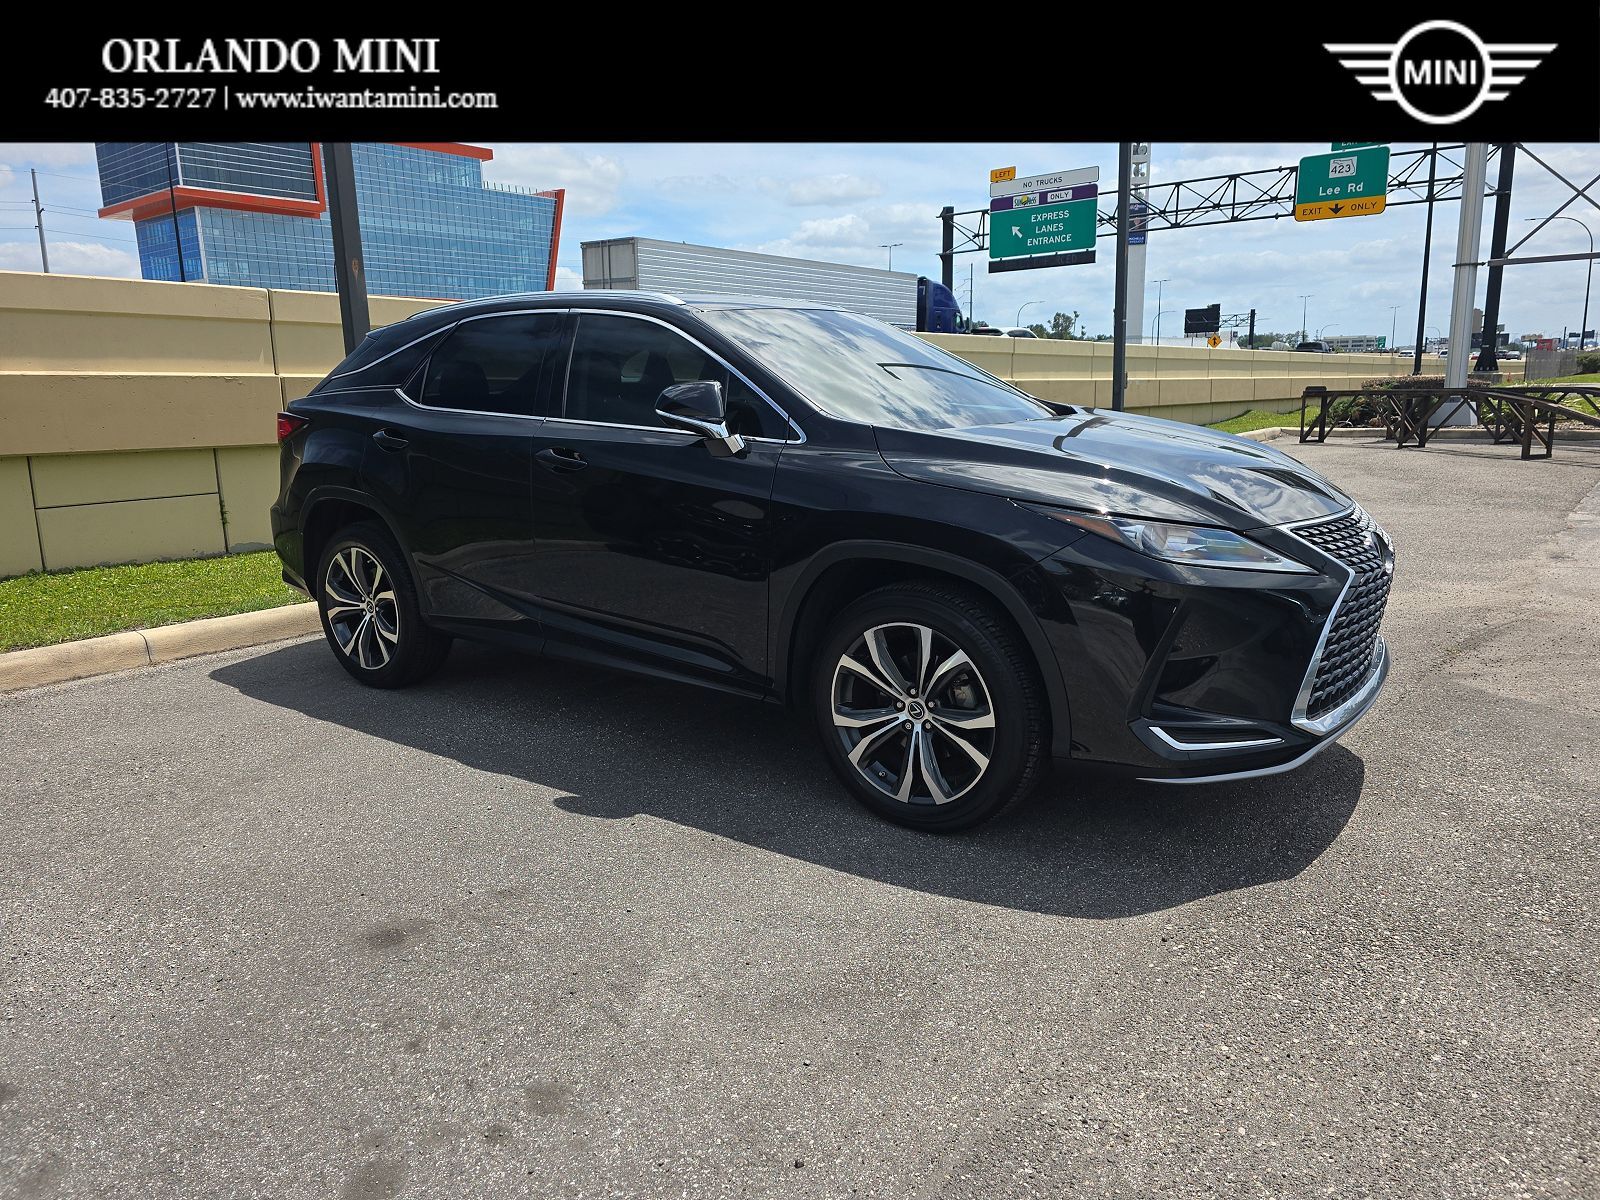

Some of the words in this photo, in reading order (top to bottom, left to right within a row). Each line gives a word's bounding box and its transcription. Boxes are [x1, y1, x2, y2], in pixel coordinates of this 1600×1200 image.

[994, 170, 1011, 179] LEFT
[1330, 164, 1351, 174] 423
[1022, 180, 1032, 188] NO
[1036, 176, 1063, 186] TRUCKS
[1319, 186, 1341, 196] Lee
[1347, 182, 1364, 192] Rd
[1050, 191, 1069, 200] ONLY
[1302, 207, 1323, 216] EXIT
[1350, 201, 1378, 211] ONLY
[1031, 210, 1070, 222] EXPRESS
[1035, 223, 1064, 234] LANES
[1027, 234, 1072, 246] ENTRANCE
